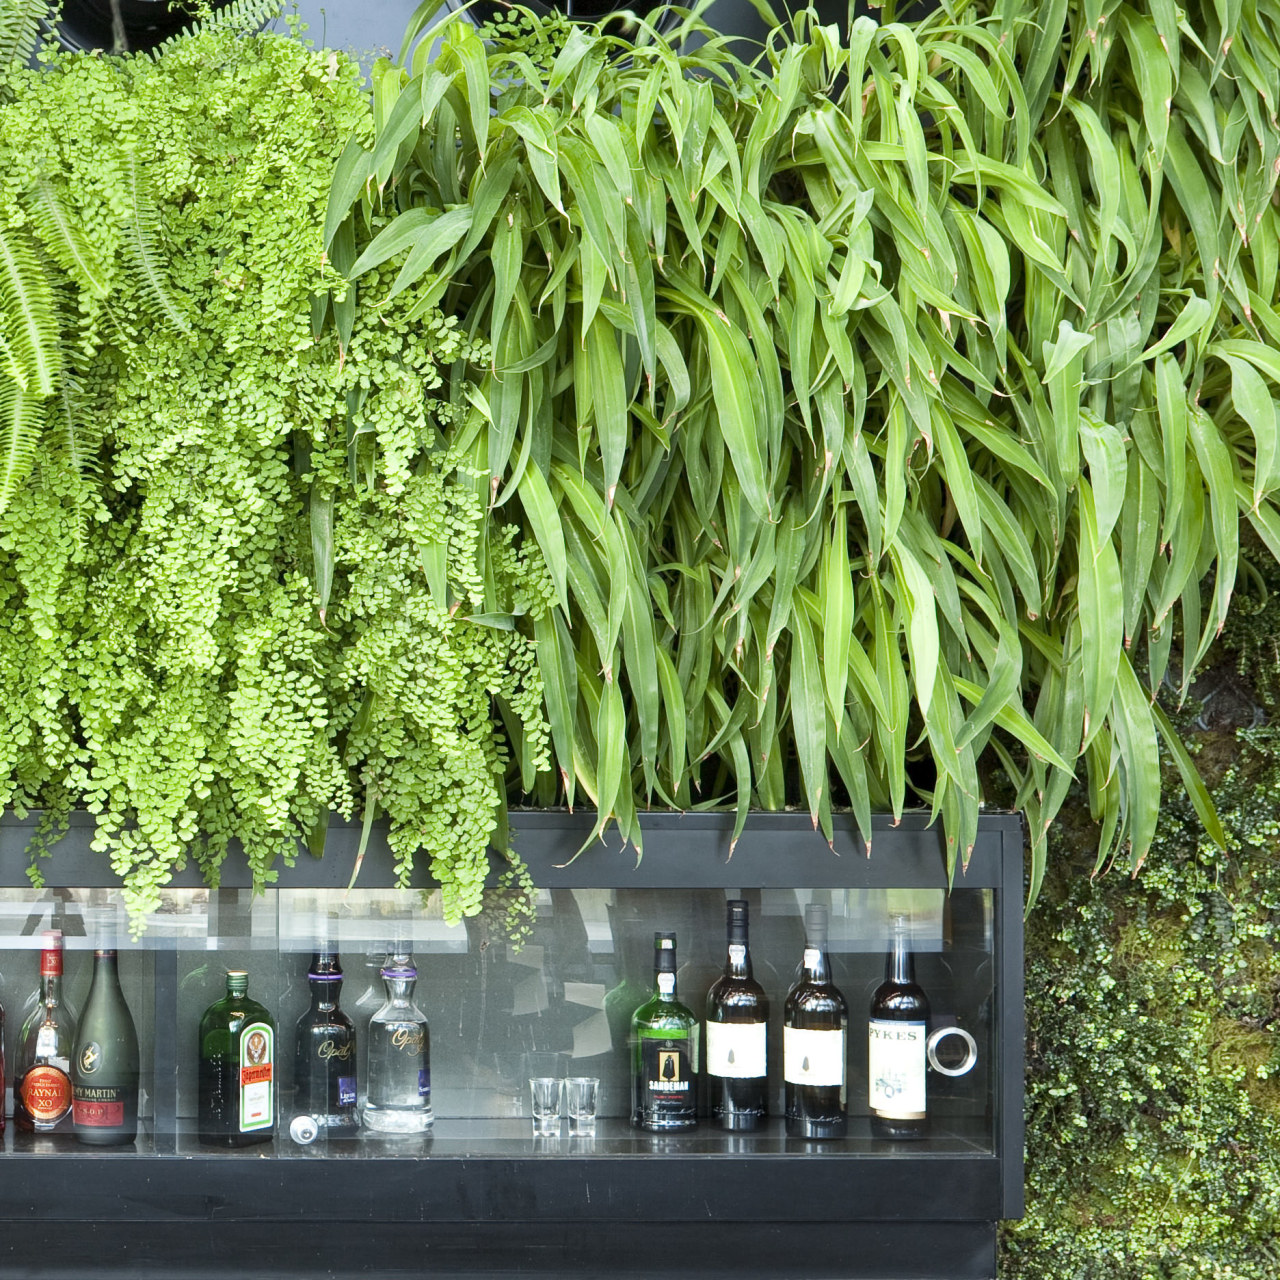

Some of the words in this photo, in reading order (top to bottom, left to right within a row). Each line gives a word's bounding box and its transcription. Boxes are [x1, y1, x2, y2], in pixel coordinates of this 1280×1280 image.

[649, 1080, 689, 1091] SANDEMAN
[84, 1088, 117, 1098] MARTIN
[38, 1099, 52, 1107] XO
